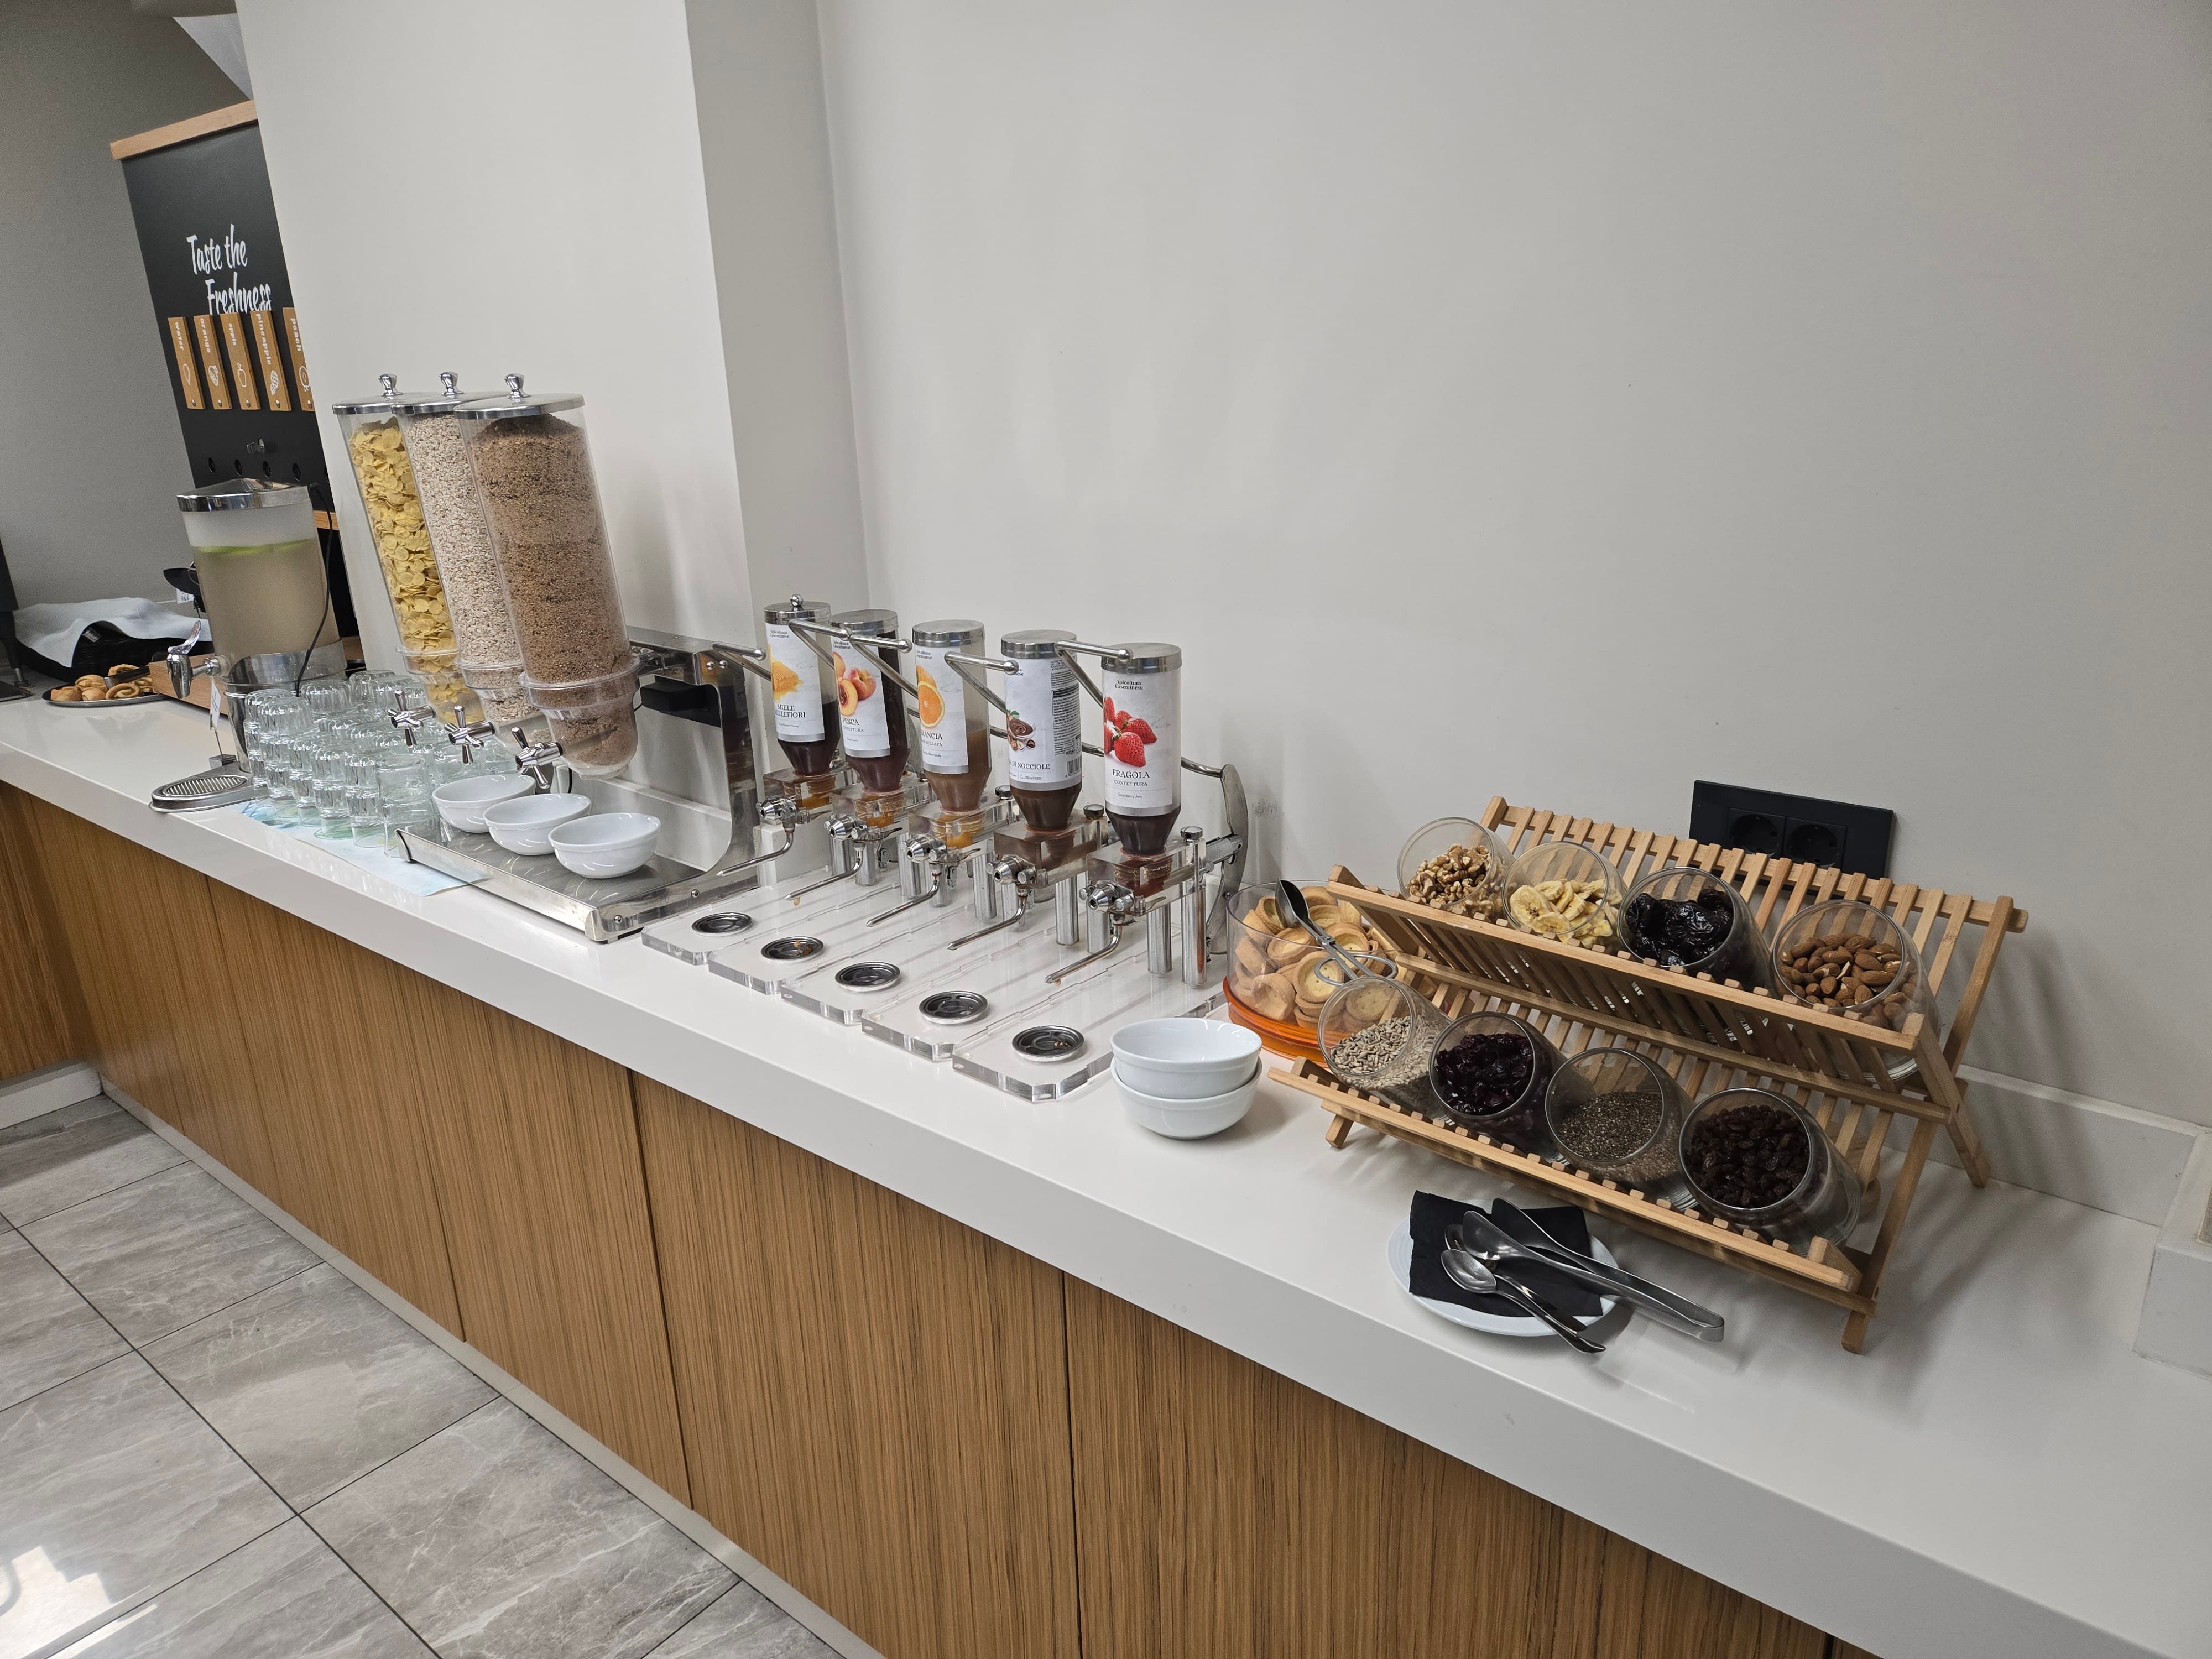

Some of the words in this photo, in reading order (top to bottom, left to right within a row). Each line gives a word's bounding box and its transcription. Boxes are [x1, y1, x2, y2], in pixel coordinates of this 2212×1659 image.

[186, 234, 223, 275] Taste
[224, 223, 248, 268] the
[205, 271, 272, 315] Freshness
[175, 322, 184, 351] water
[200, 318, 211, 353] orange
[228, 322, 237, 346] apple
[256, 314, 271, 365] pineapple
[290, 318, 302, 352] peach
[843, 717, 859, 726] PESCA
[1112, 769, 1150, 779] FRAGOLA
